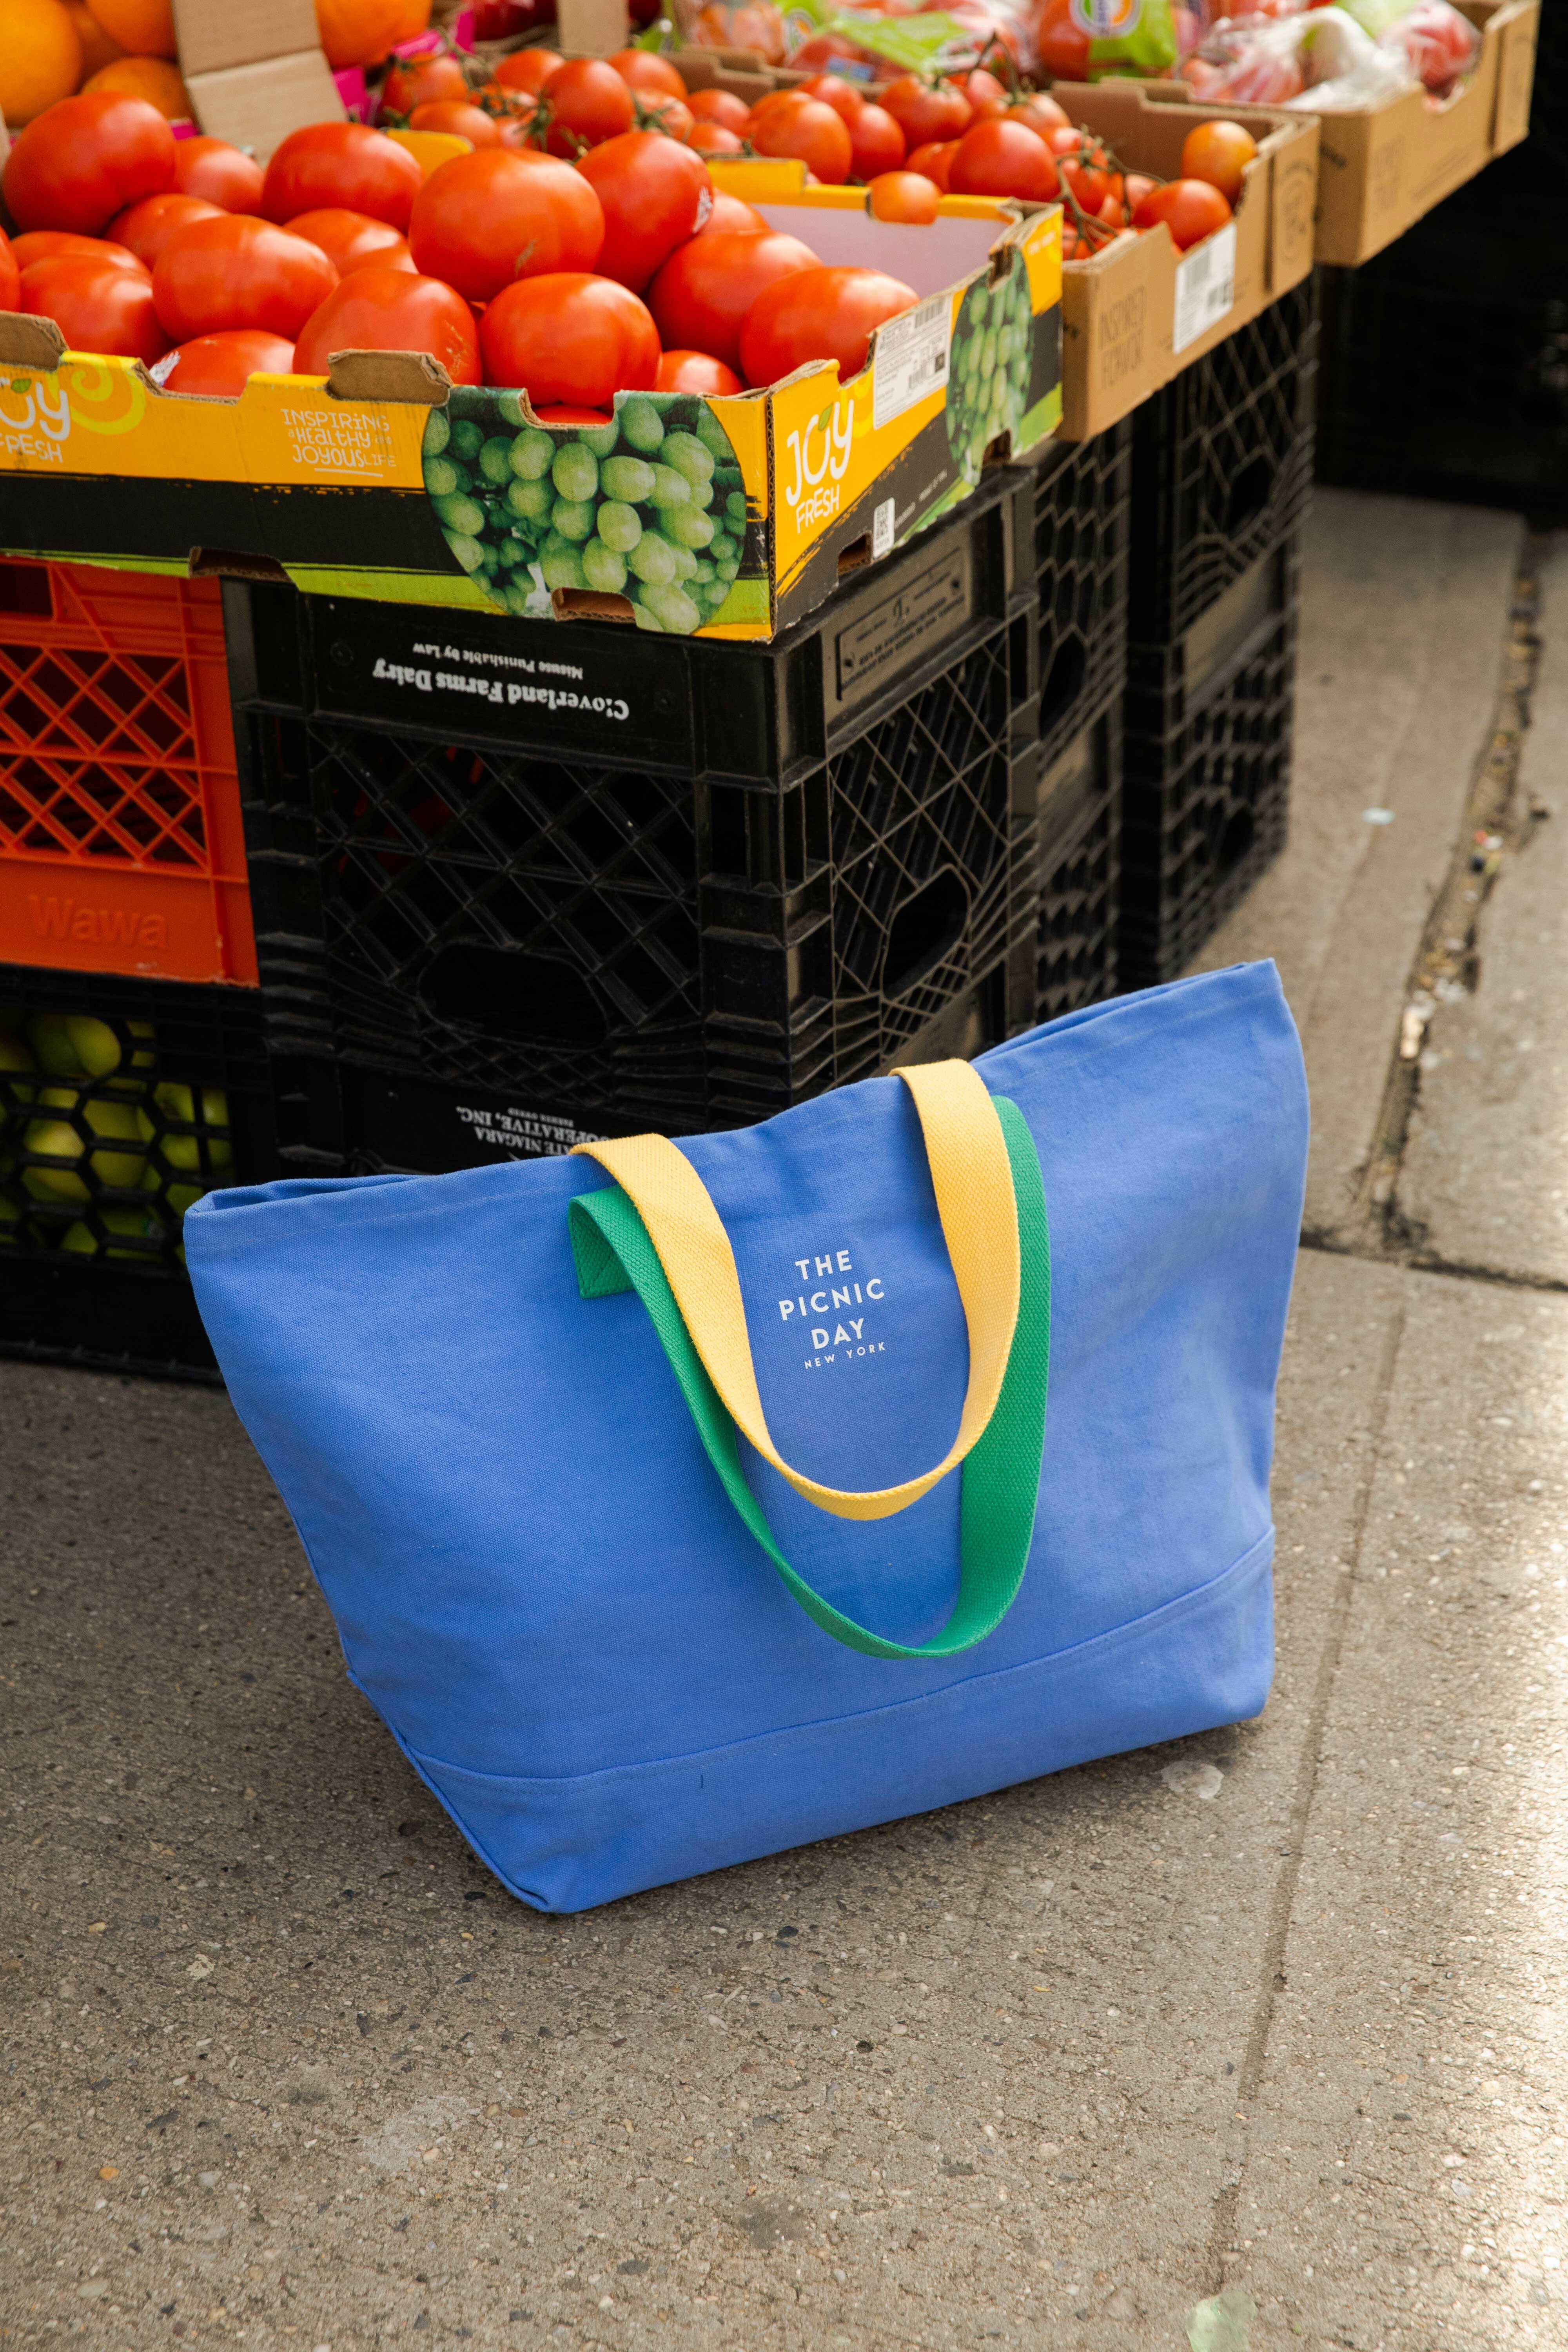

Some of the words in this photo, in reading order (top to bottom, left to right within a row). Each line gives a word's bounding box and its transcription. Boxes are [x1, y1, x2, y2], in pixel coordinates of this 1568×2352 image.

[363, 454, 397, 467] LIFE
[796, 483, 840, 534] FRESH
[412, 642, 440, 659] Law
[444, 645, 460, 662] by
[463, 650, 535, 673] Punishable
[373, 657, 433, 692] Dairy
[538, 661, 583, 680] Misuse
[435, 671, 504, 703] Farms
[507, 683, 630, 720] Cloverland
[29, 894, 169, 949] Wawa
[455, 1106, 492, 1127] INC.
[495, 1112, 610, 1144] OPERATIVE,
[474, 1125, 542, 1154] NIAGARA
[795, 1249, 852, 1280] THE
[779, 1278, 885, 1321] PICNIC
[811, 1318, 864, 1350] DAY
[804, 1354, 835, 1369] NEW
[846, 1342, 886, 1359] YORK
